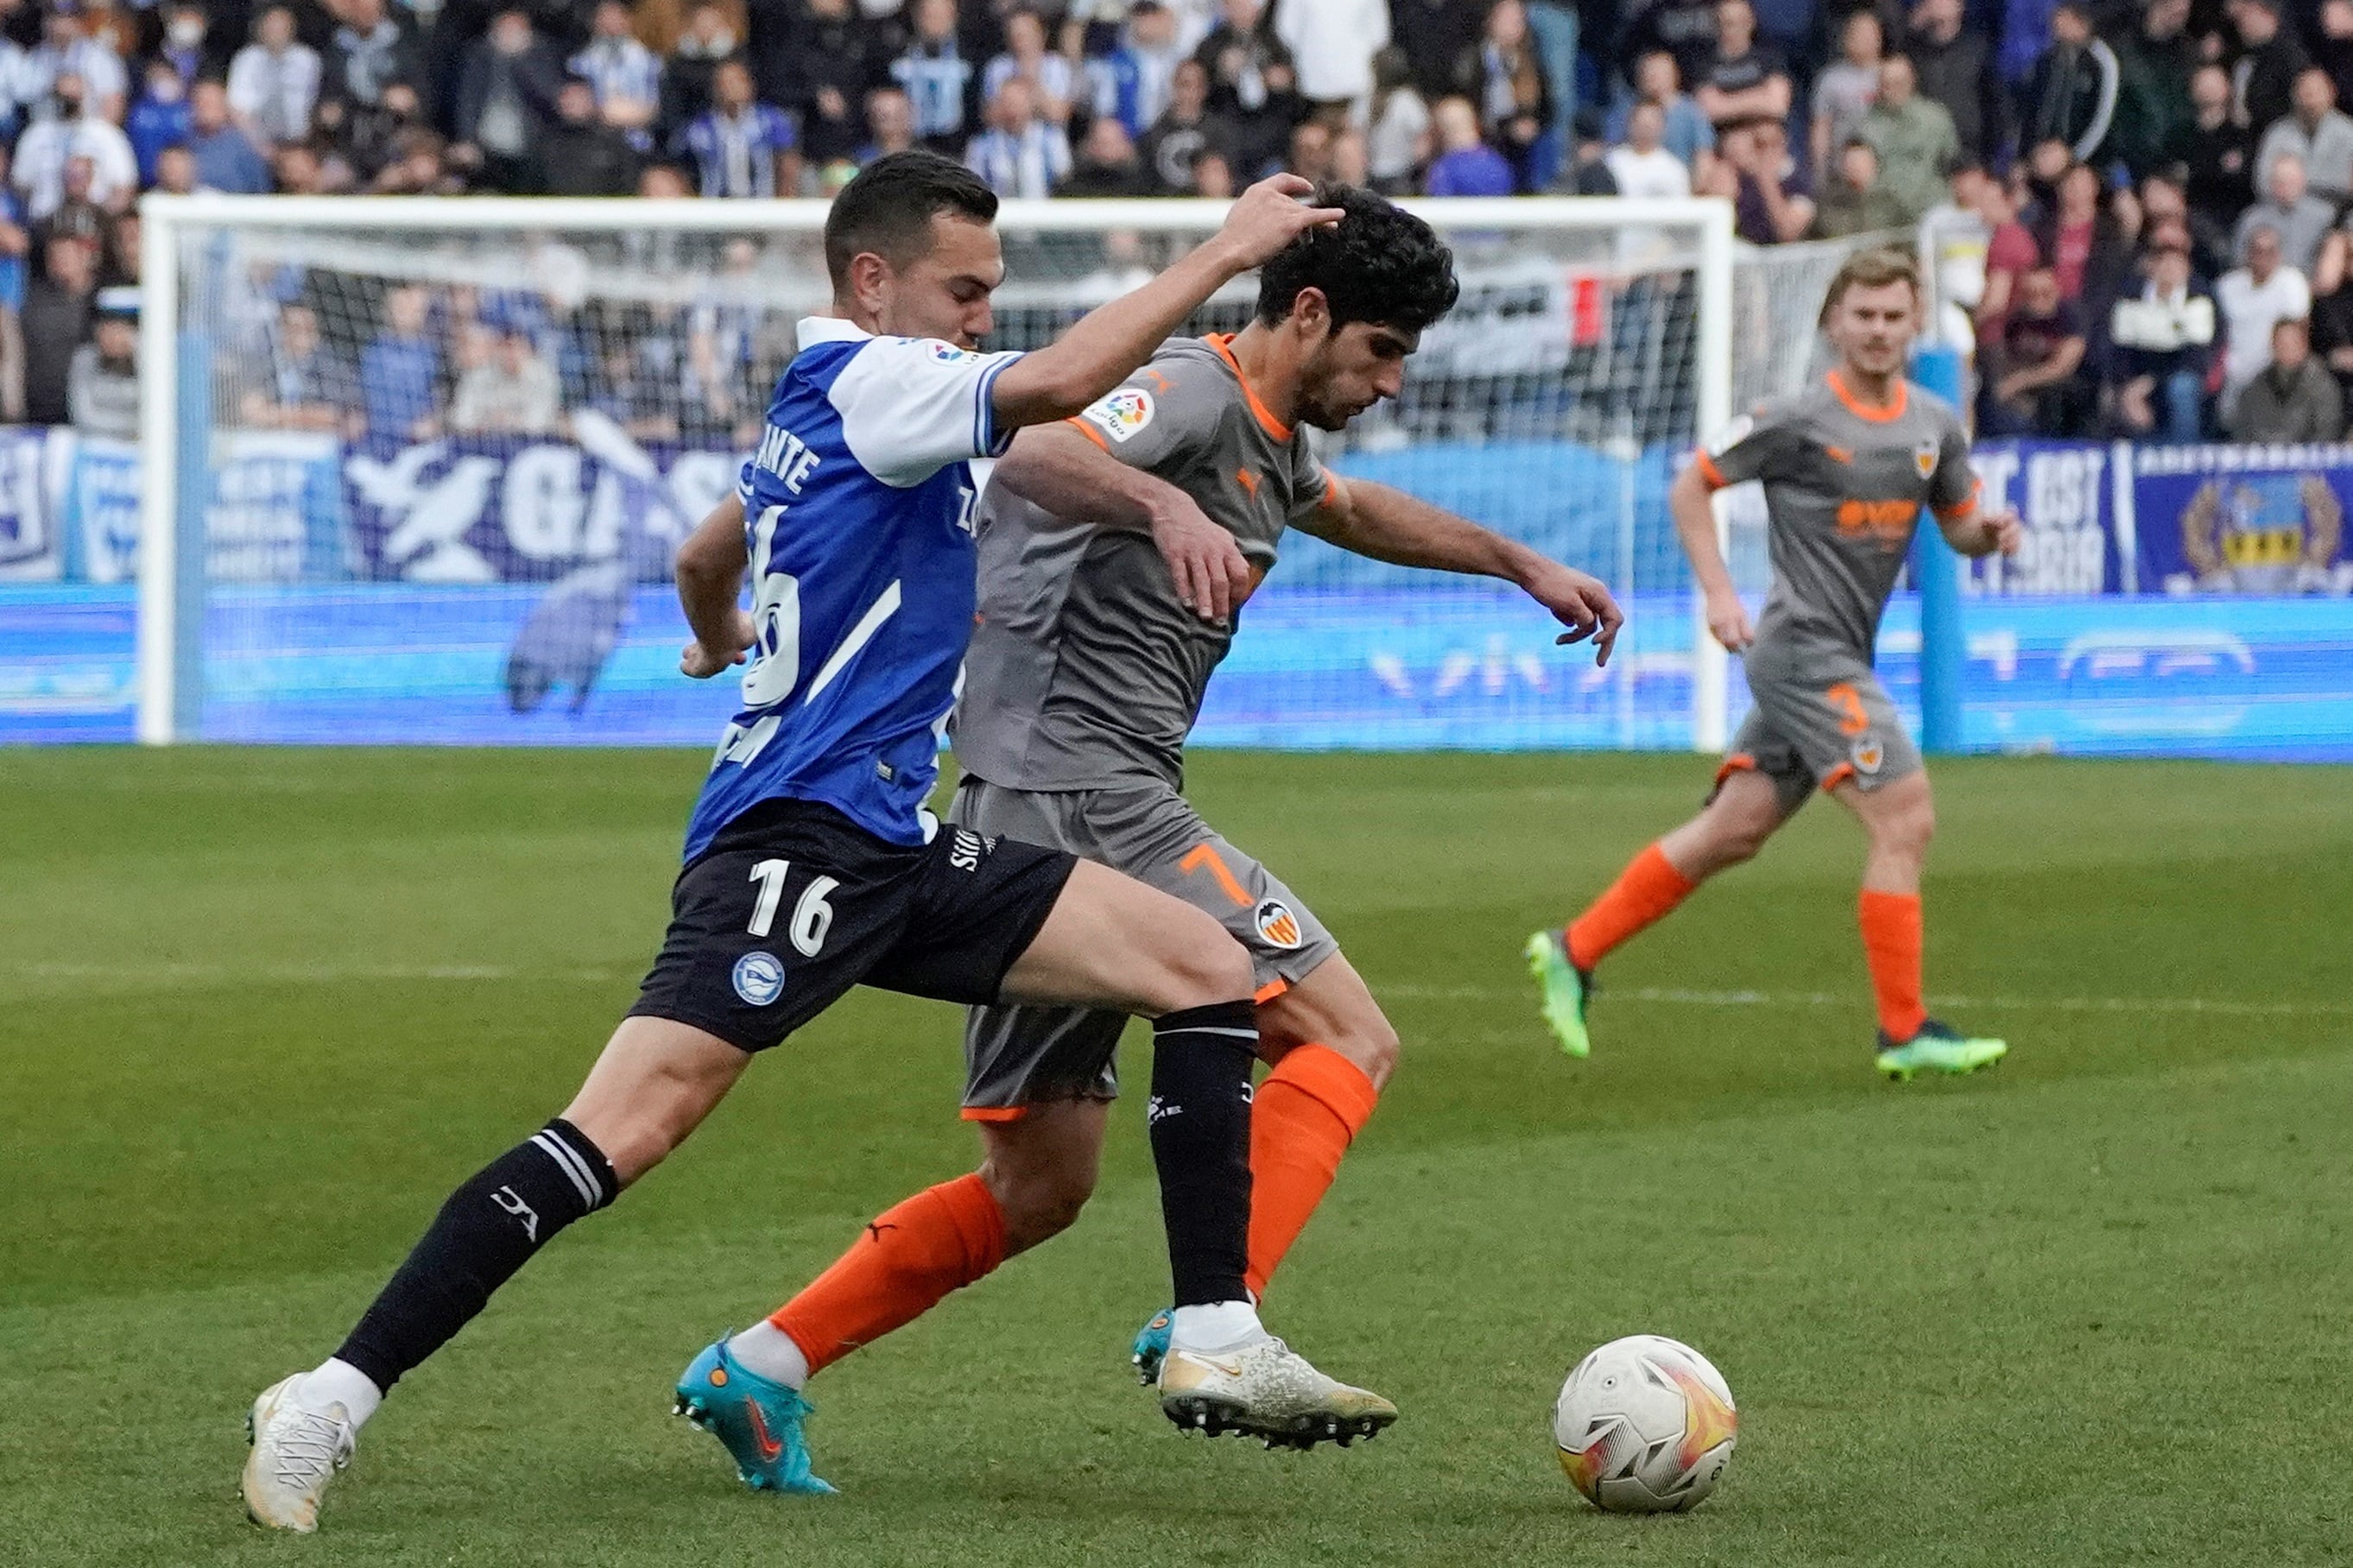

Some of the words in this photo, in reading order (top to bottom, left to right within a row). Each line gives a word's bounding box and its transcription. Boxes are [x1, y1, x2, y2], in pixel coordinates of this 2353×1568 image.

[1825, 681, 1869, 737] 3
[1178, 842, 1257, 907] 7
[747, 858, 840, 958] 16
